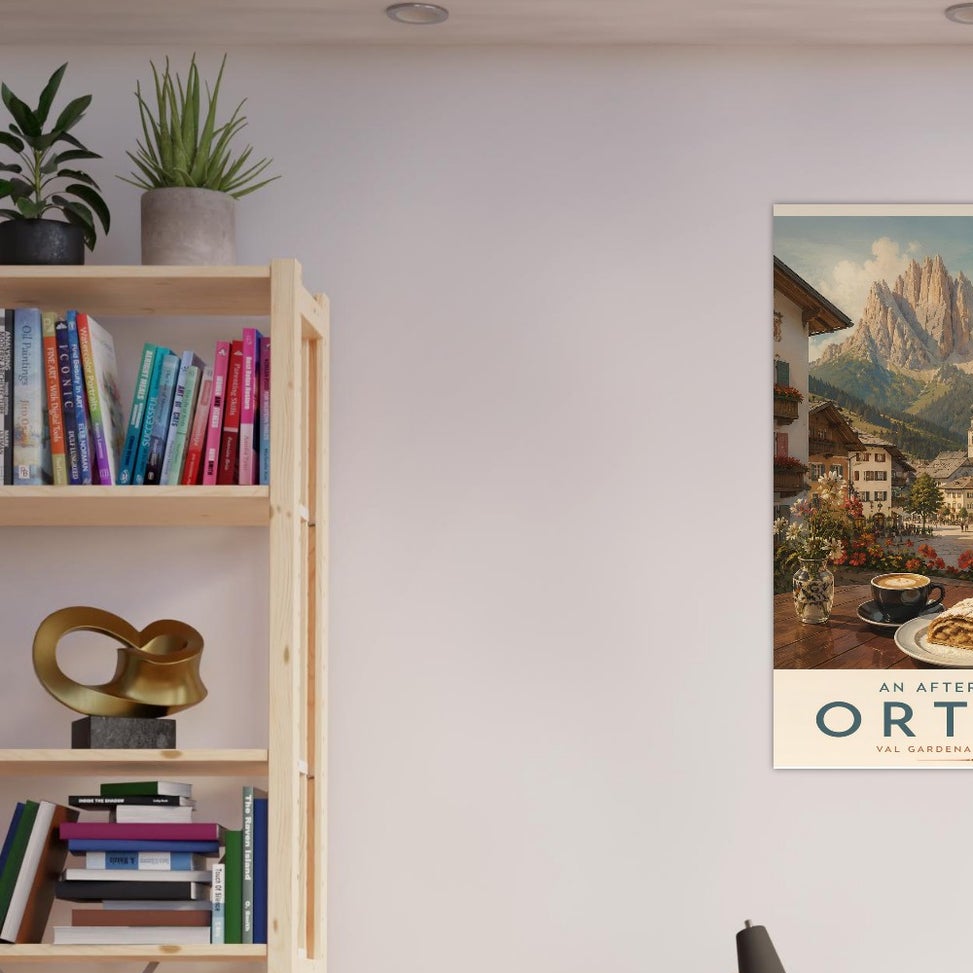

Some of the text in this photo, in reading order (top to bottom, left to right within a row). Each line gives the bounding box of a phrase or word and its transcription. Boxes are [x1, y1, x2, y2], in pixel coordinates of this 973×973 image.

[19, 325, 31, 386] Oil Paintings
[47, 347, 55, 364] FINE
[71, 344, 79, 358] Find
[59, 344, 73, 409] ICONIC
[72, 359, 81, 385] Beauty
[79, 326, 98, 412] Watercolor Portraits
[49, 384, 58, 402] With
[229, 363, 240, 417] Parenting Skills
[49, 402, 59, 425] Digital
[53, 426, 61, 443] Tools
[79, 440, 89, 472] NORMAN
[879, 682, 903, 692] AN
[244, 794, 252, 881] The Raven Island
